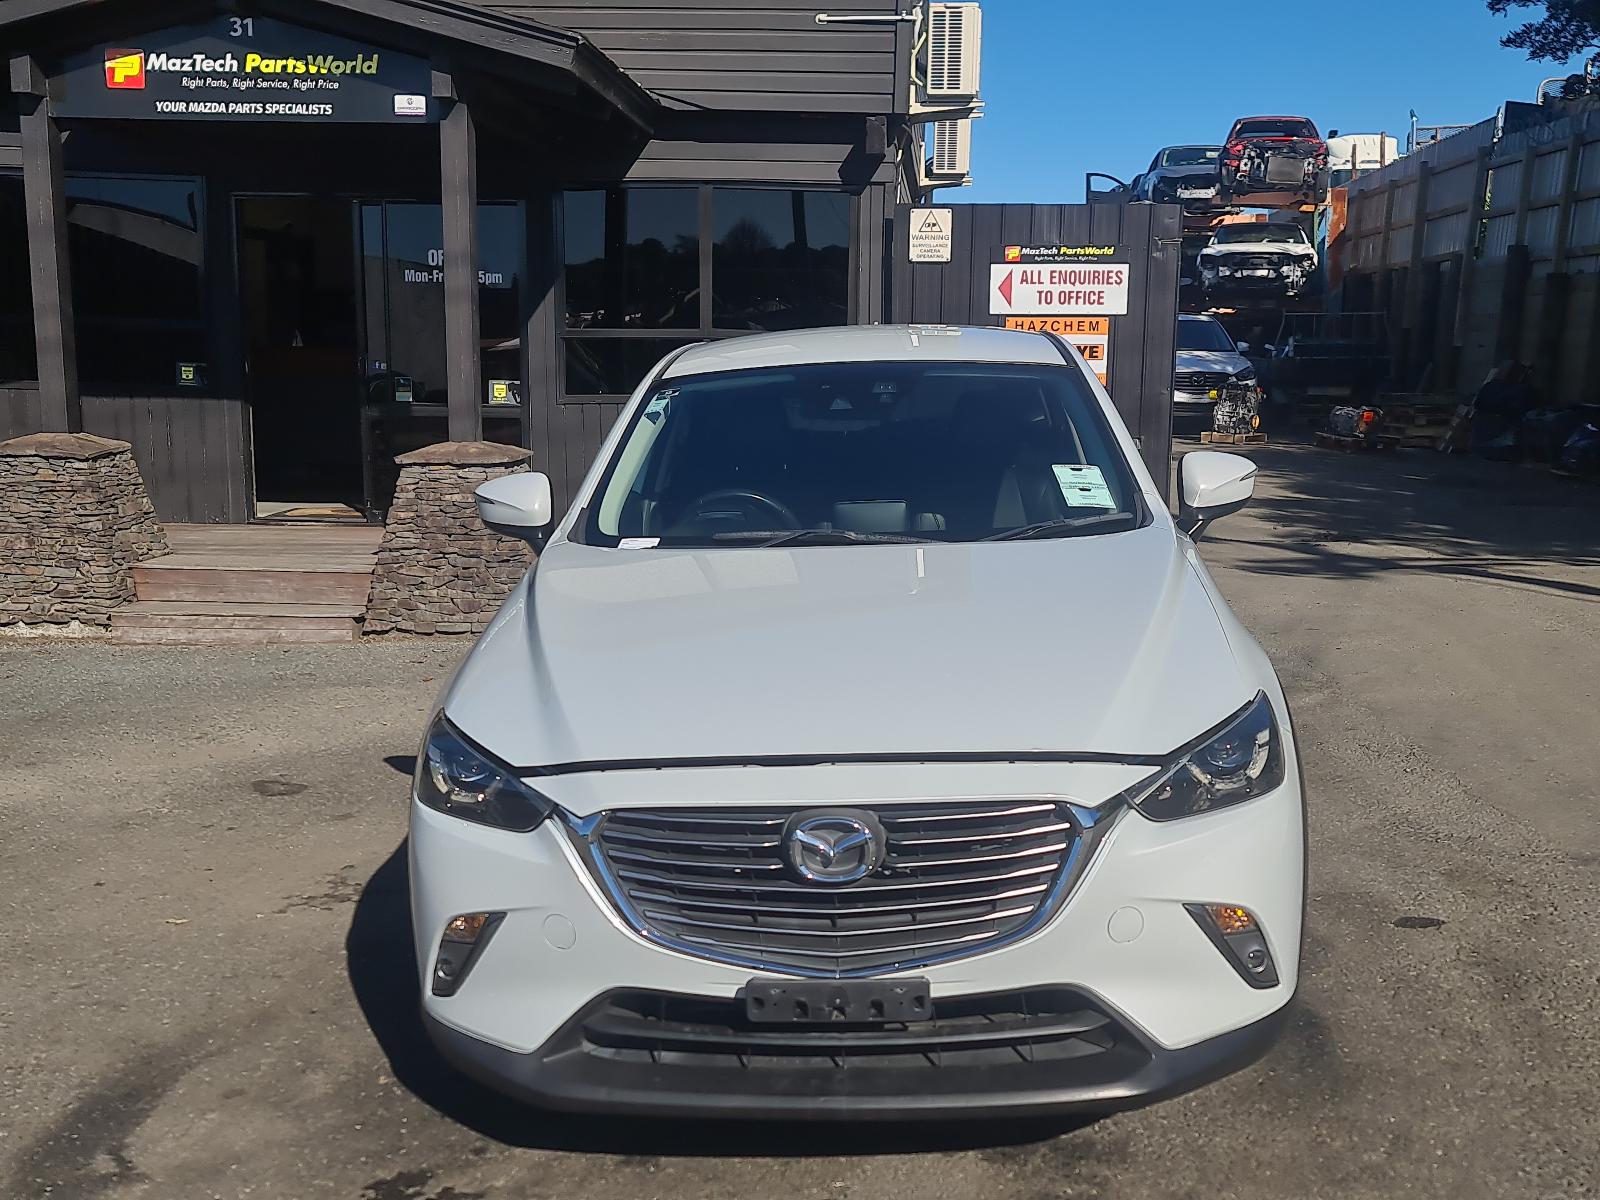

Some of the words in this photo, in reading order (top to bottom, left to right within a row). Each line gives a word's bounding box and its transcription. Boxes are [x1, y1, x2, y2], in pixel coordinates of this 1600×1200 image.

[229, 17, 253, 37] 31
[146, 53, 238, 72] MazTech
[245, 53, 379, 75] PartsWorld
[181, 77, 203, 89] Right
[205, 77, 230, 89] Parts,
[232, 78, 255, 90] Right
[256, 78, 290, 90] Service,
[293, 79, 316, 91] Right
[317, 79, 340, 90] Price
[155, 101, 187, 113] YOUR
[188, 102, 226, 114] MAZDA
[228, 103, 263, 114] PARTS
[265, 103, 333, 115] SPECIALISTS
[1021, 246, 1058, 255] MazTech
[1060, 246, 1115, 256] PartsWorld
[404, 269, 444, 282] Mon-Fr
[1020, 270, 1044, 285] ALL
[1049, 270, 1124, 286] ENQUIRIES
[1037, 290, 1053, 305] TO
[1058, 290, 1105, 305] OFFICE
[1015, 320, 1100, 331] HAZCHEM
[1075, 345, 1099, 359] YE
